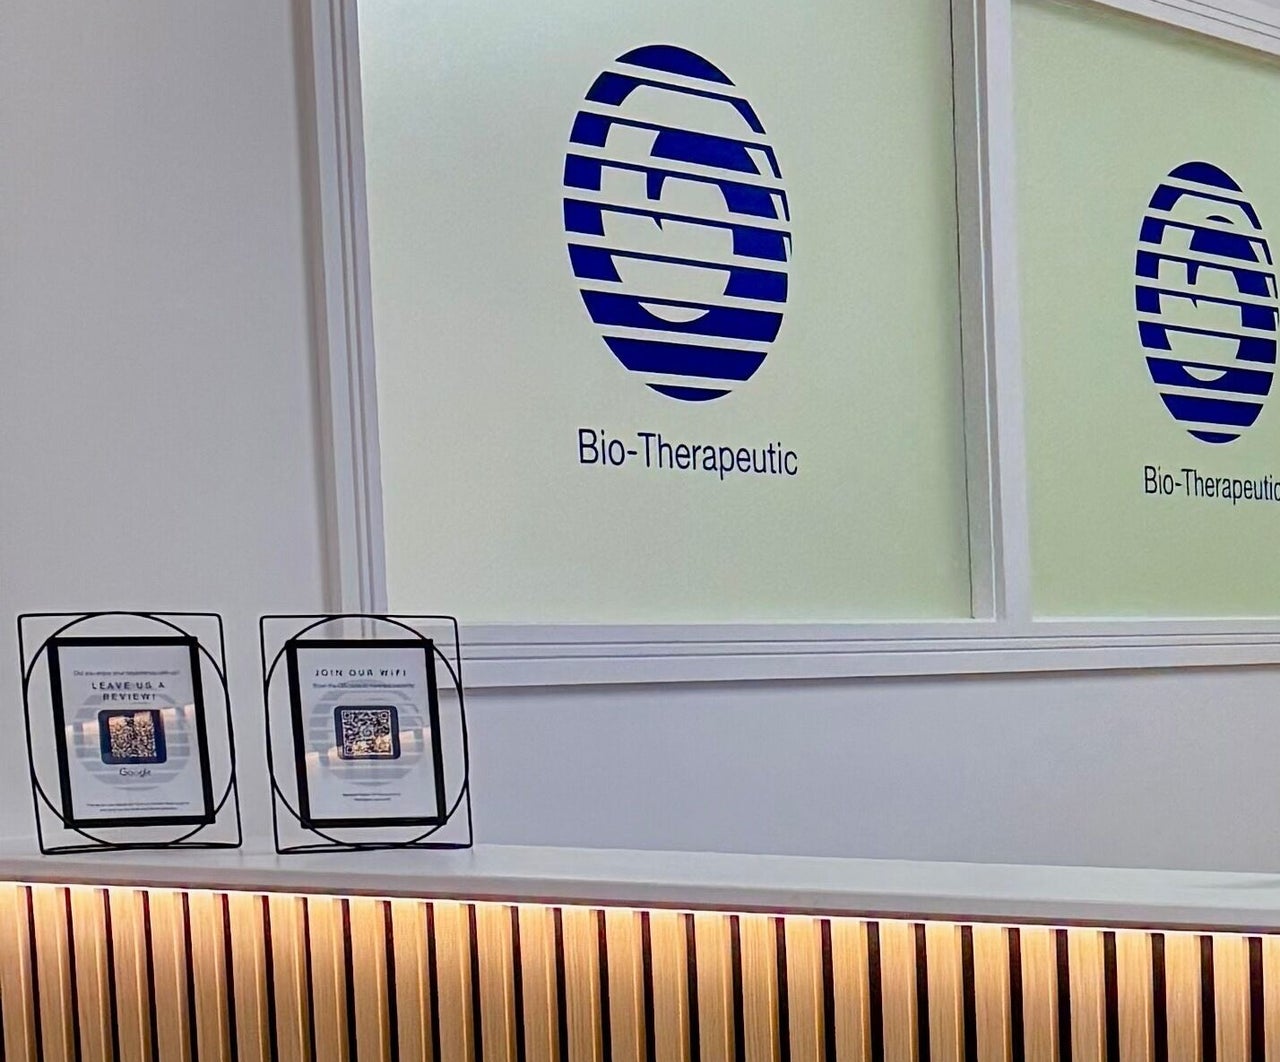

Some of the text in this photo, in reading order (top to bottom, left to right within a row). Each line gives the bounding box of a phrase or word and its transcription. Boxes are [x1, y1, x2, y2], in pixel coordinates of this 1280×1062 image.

[577, 428, 798, 481] Bio-Therapeutic
[315, 669, 343, 677] JOIN
[349, 669, 373, 677] OUR
[91, 681, 165, 690] LEAVE US A
